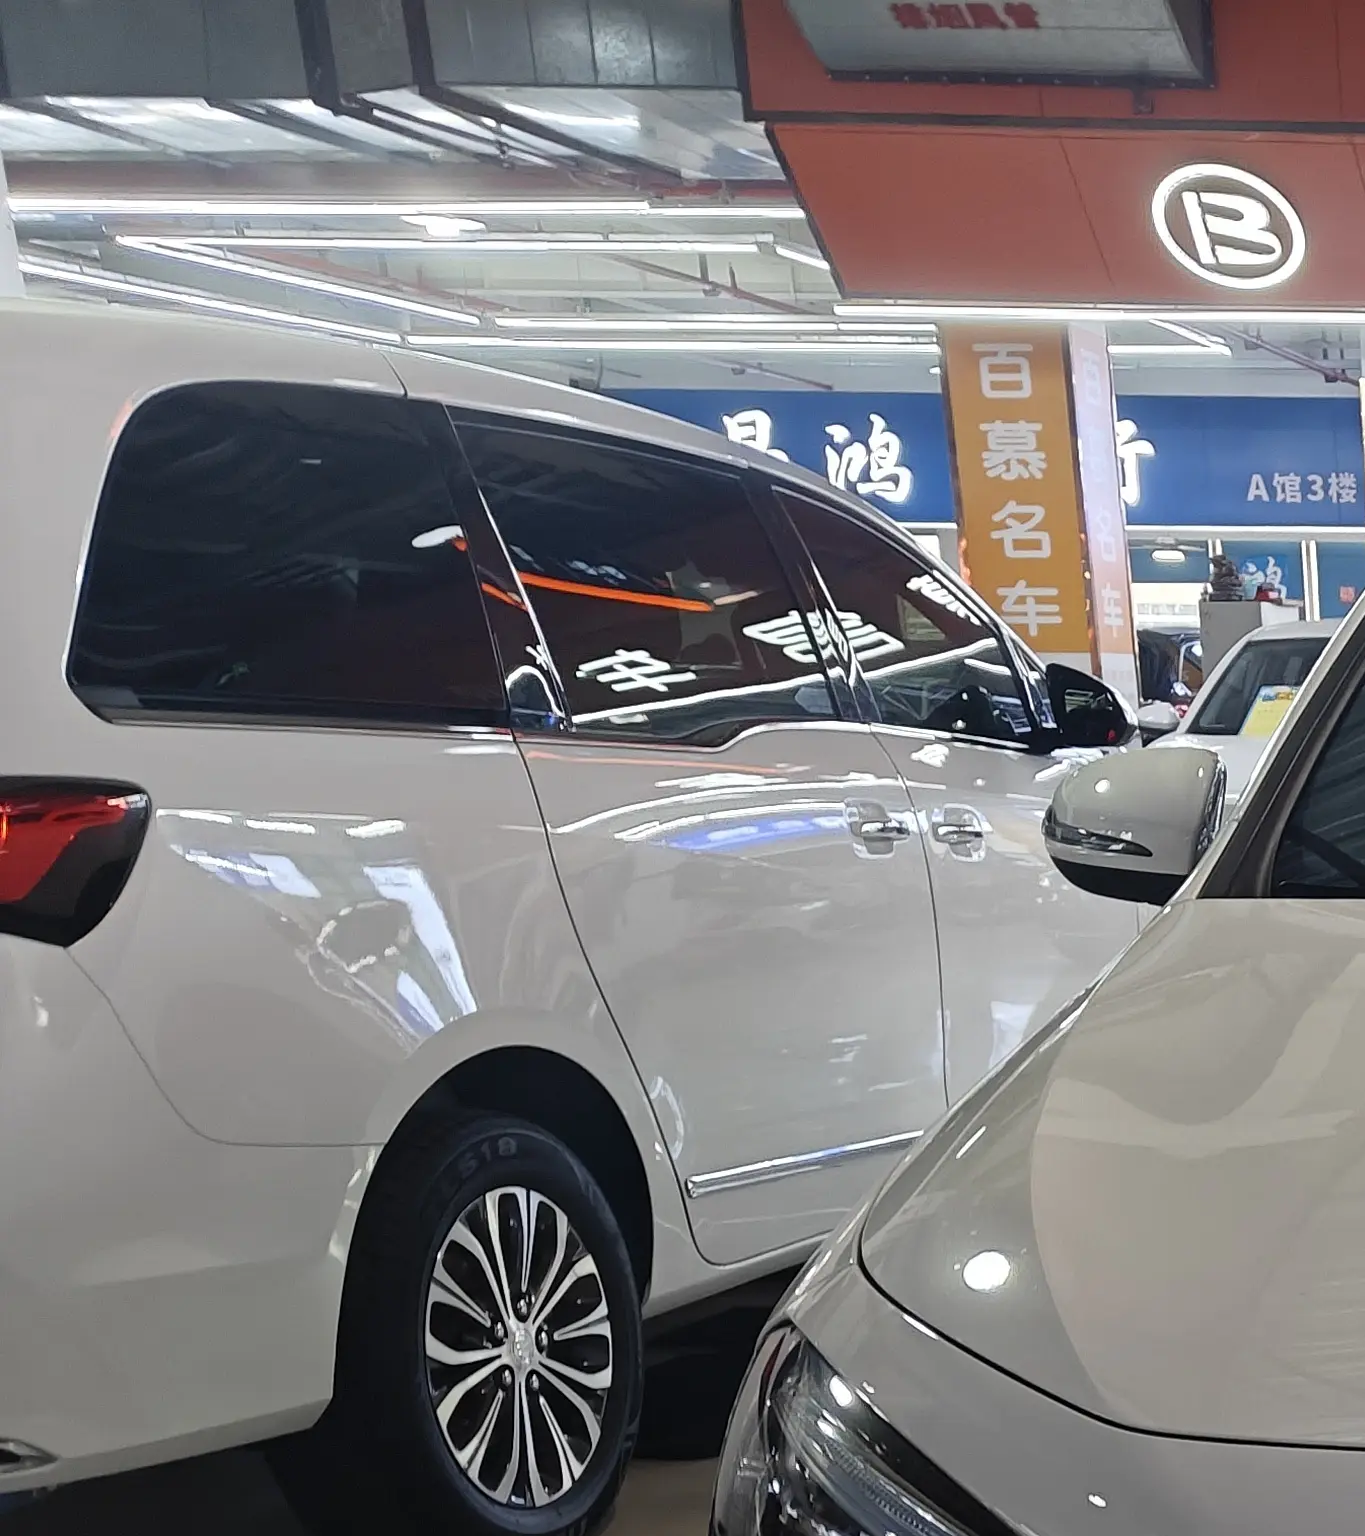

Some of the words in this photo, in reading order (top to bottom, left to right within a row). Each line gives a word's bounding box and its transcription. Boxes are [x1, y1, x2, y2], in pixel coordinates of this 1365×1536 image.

[971, 342, 1064, 637] 百慕名车
[1247, 472, 1357, 504] A馆3楼
